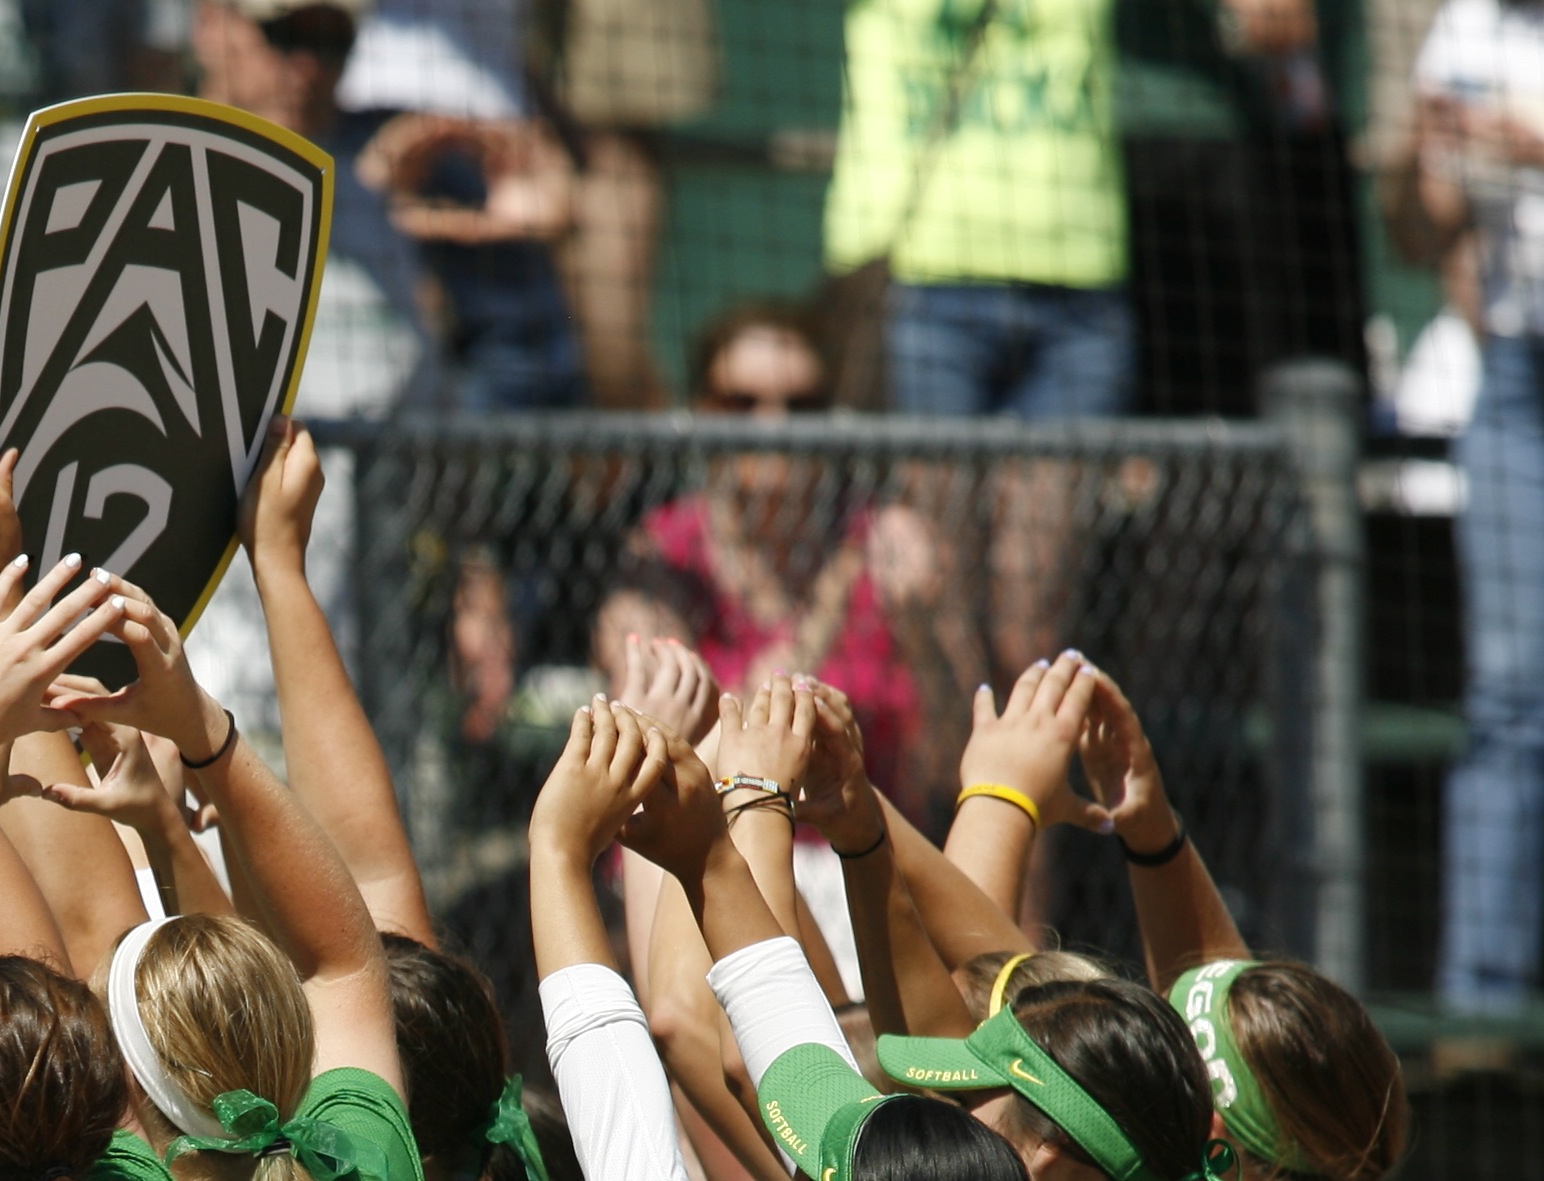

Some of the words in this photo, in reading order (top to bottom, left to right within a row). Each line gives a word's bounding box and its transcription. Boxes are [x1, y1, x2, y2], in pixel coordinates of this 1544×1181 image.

[38, 460, 173, 642] 12
[906, 1067, 978, 1081] SOFTBALL
[766, 1100, 808, 1155] SOFTBALL
